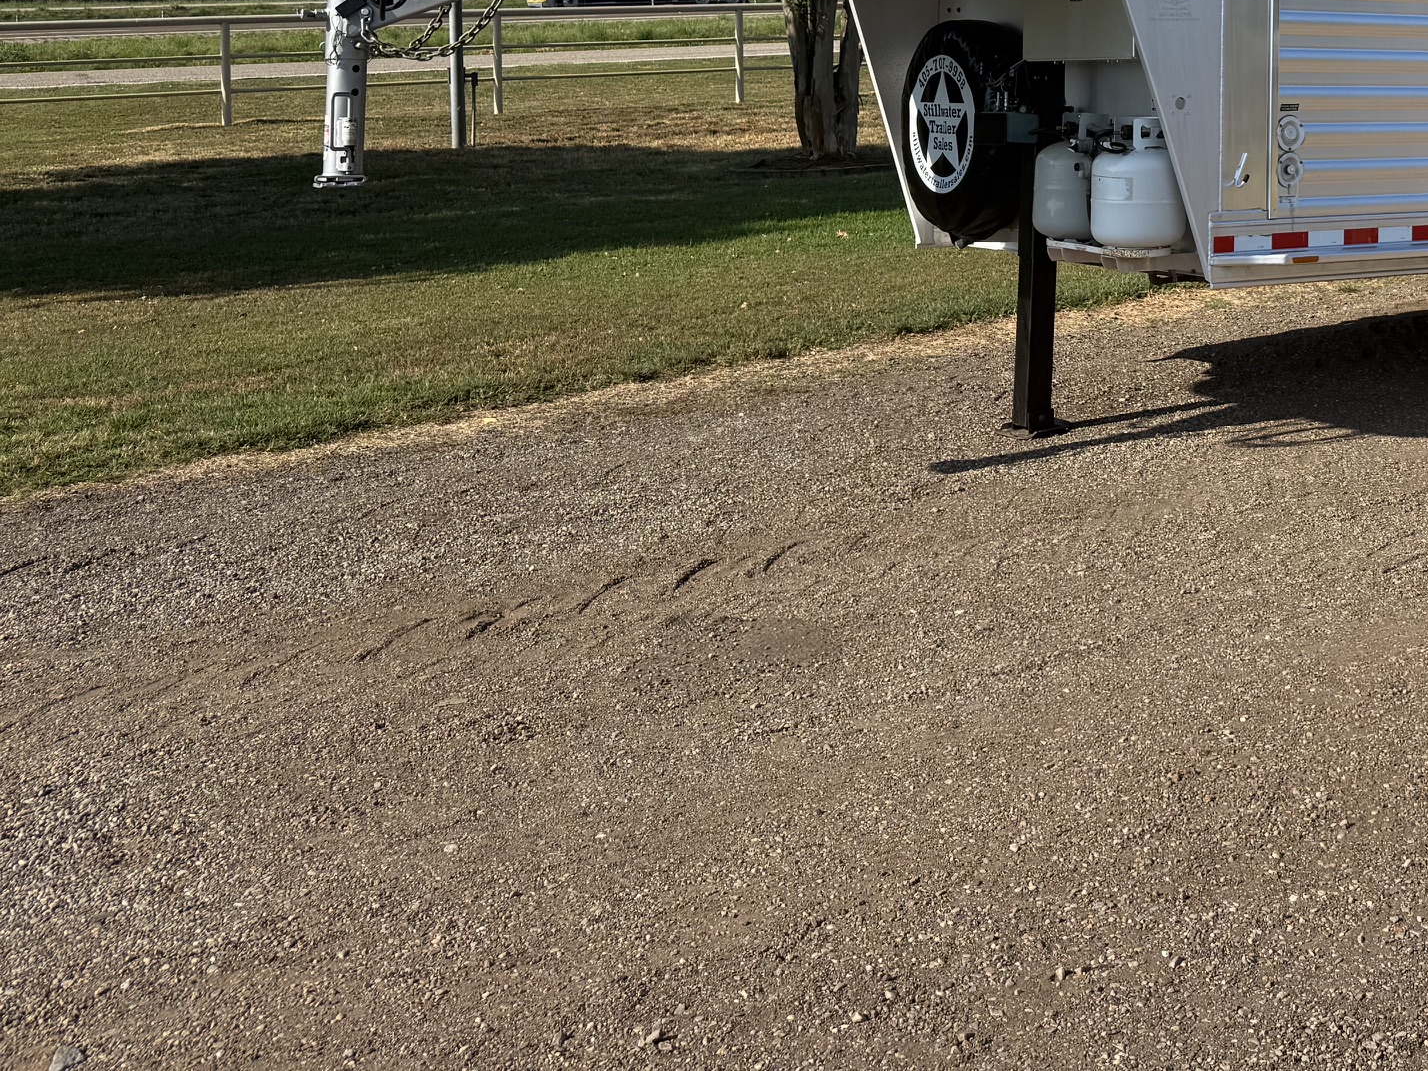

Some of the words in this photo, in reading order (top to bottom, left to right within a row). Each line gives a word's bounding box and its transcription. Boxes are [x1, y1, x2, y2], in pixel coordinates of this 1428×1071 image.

[923, 103, 962, 119] Stillwater
[929, 120, 957, 135] Trailer
[933, 136, 953, 151] Sales
